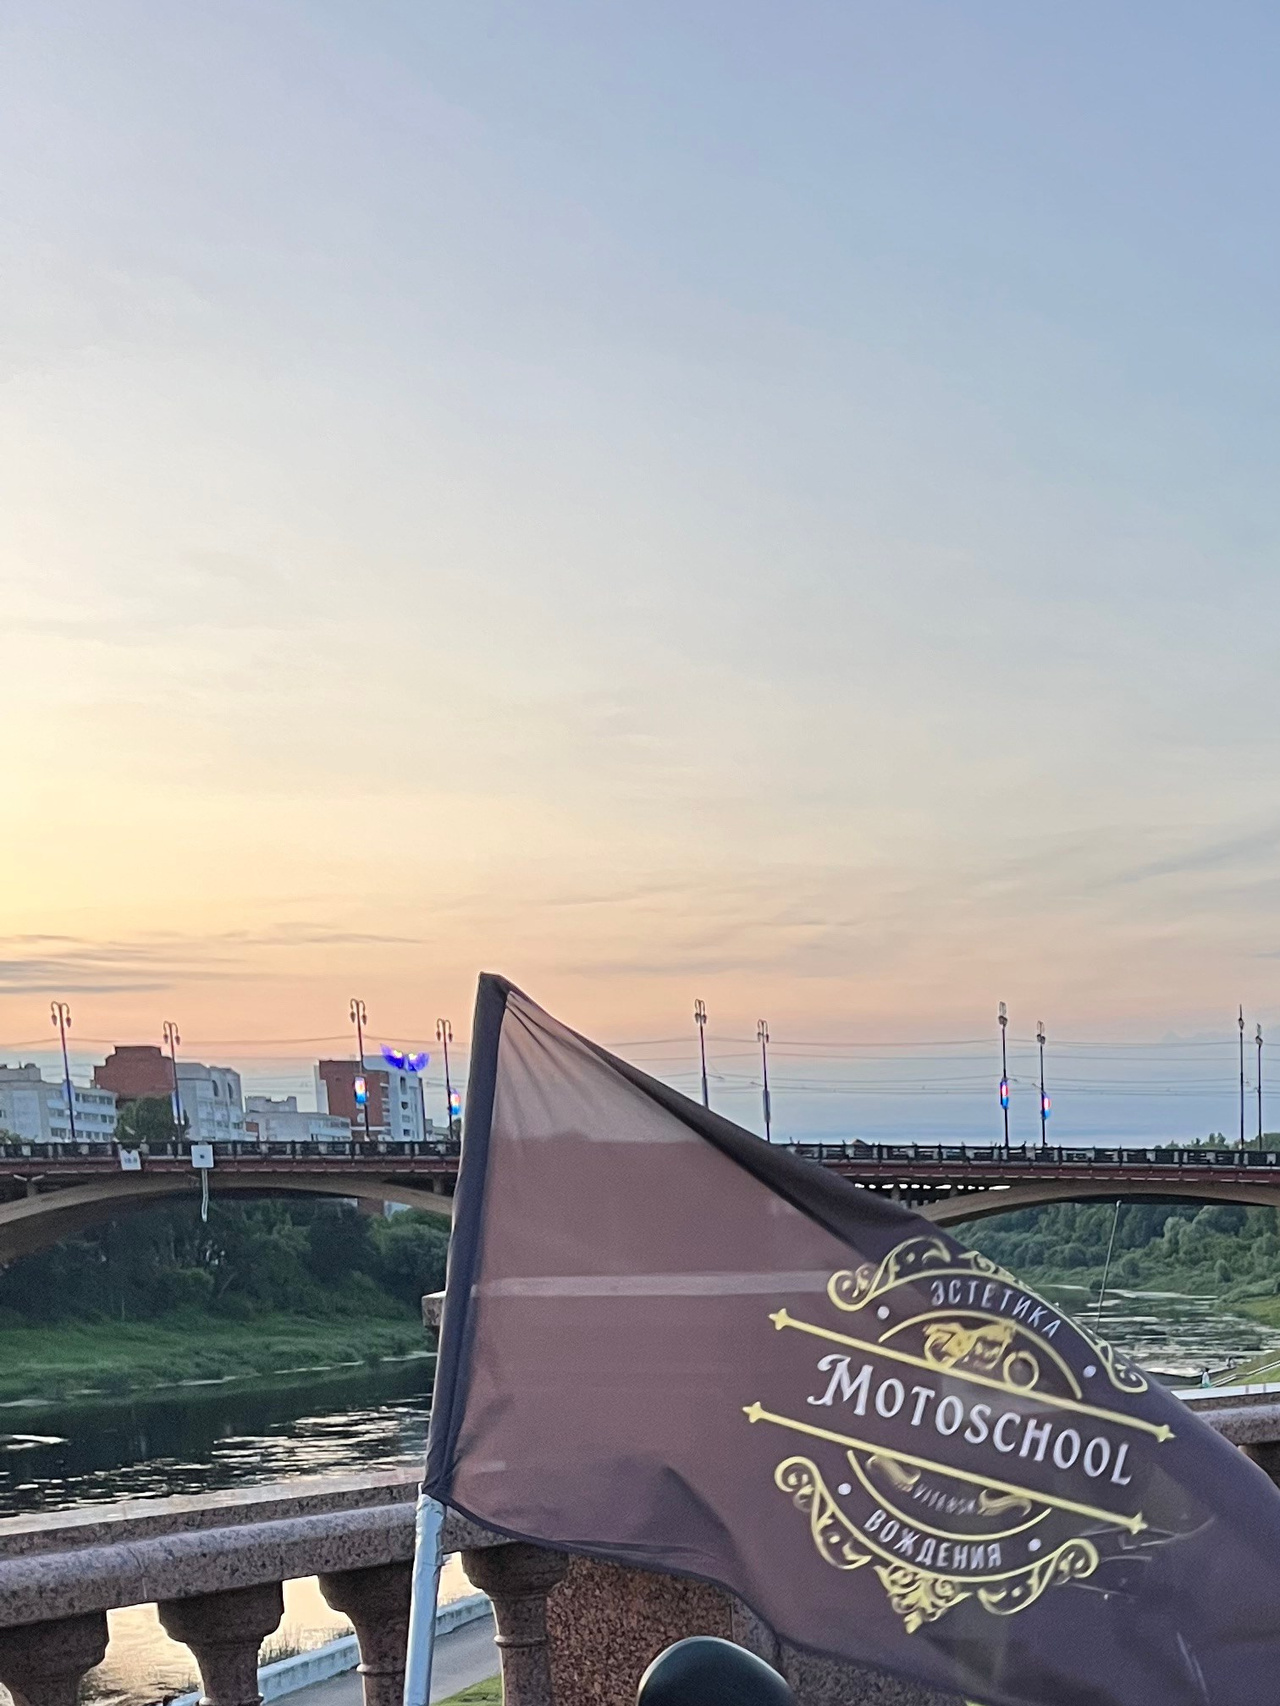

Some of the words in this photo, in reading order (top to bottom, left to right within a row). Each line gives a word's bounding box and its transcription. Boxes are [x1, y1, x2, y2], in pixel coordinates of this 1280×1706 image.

[930, 1279, 1061, 1338] ЭСТЕТИКА
[807, 1354, 1132, 1485] MOTOSCHOOL
[863, 1509, 1002, 1570] ВОЖДЕНИЯ
